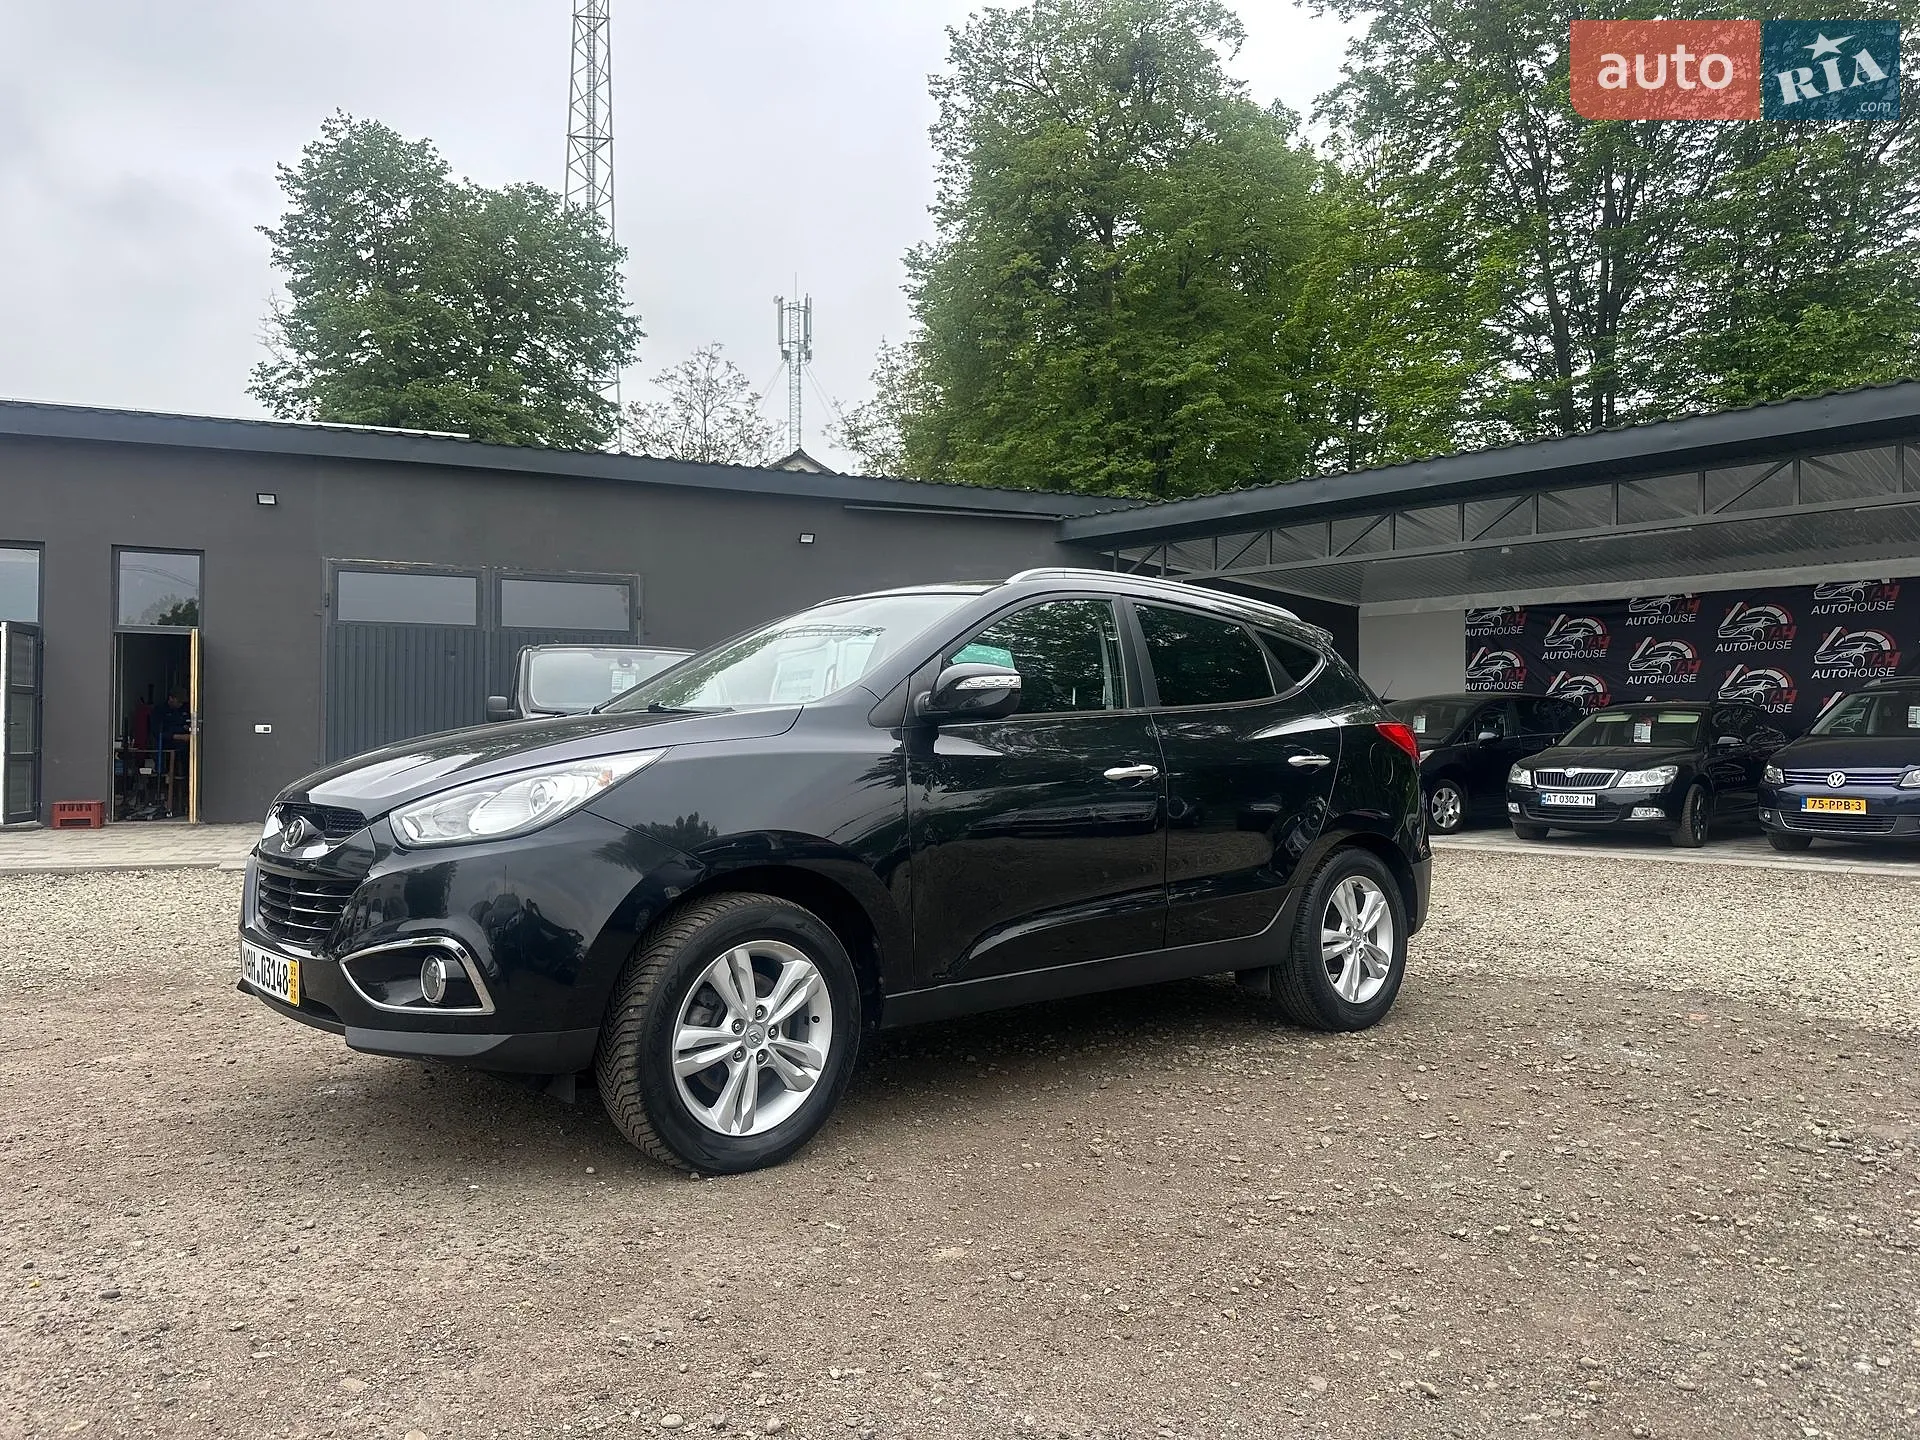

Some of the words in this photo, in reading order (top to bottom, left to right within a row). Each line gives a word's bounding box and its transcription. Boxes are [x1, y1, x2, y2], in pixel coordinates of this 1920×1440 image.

[1811, 600, 1896, 615] AUTOHOUSE
[1625, 613, 1697, 626] AUTOHOUSE
[1465, 625, 1525, 637] AUTOHOUSE
[1715, 639, 1793, 653] AUTOHOUSE
[1541, 648, 1608, 661] AUTOHOUSE
[1811, 666, 1896, 679] AUTOHOUSE
[1626, 673, 1697, 685] AUTOHOUSE
[1465, 680, 1525, 691] AUTOHOUSE
[1559, 795, 1580, 804] 0302
[1810, 799, 1862, 811] 75-PPB-3
